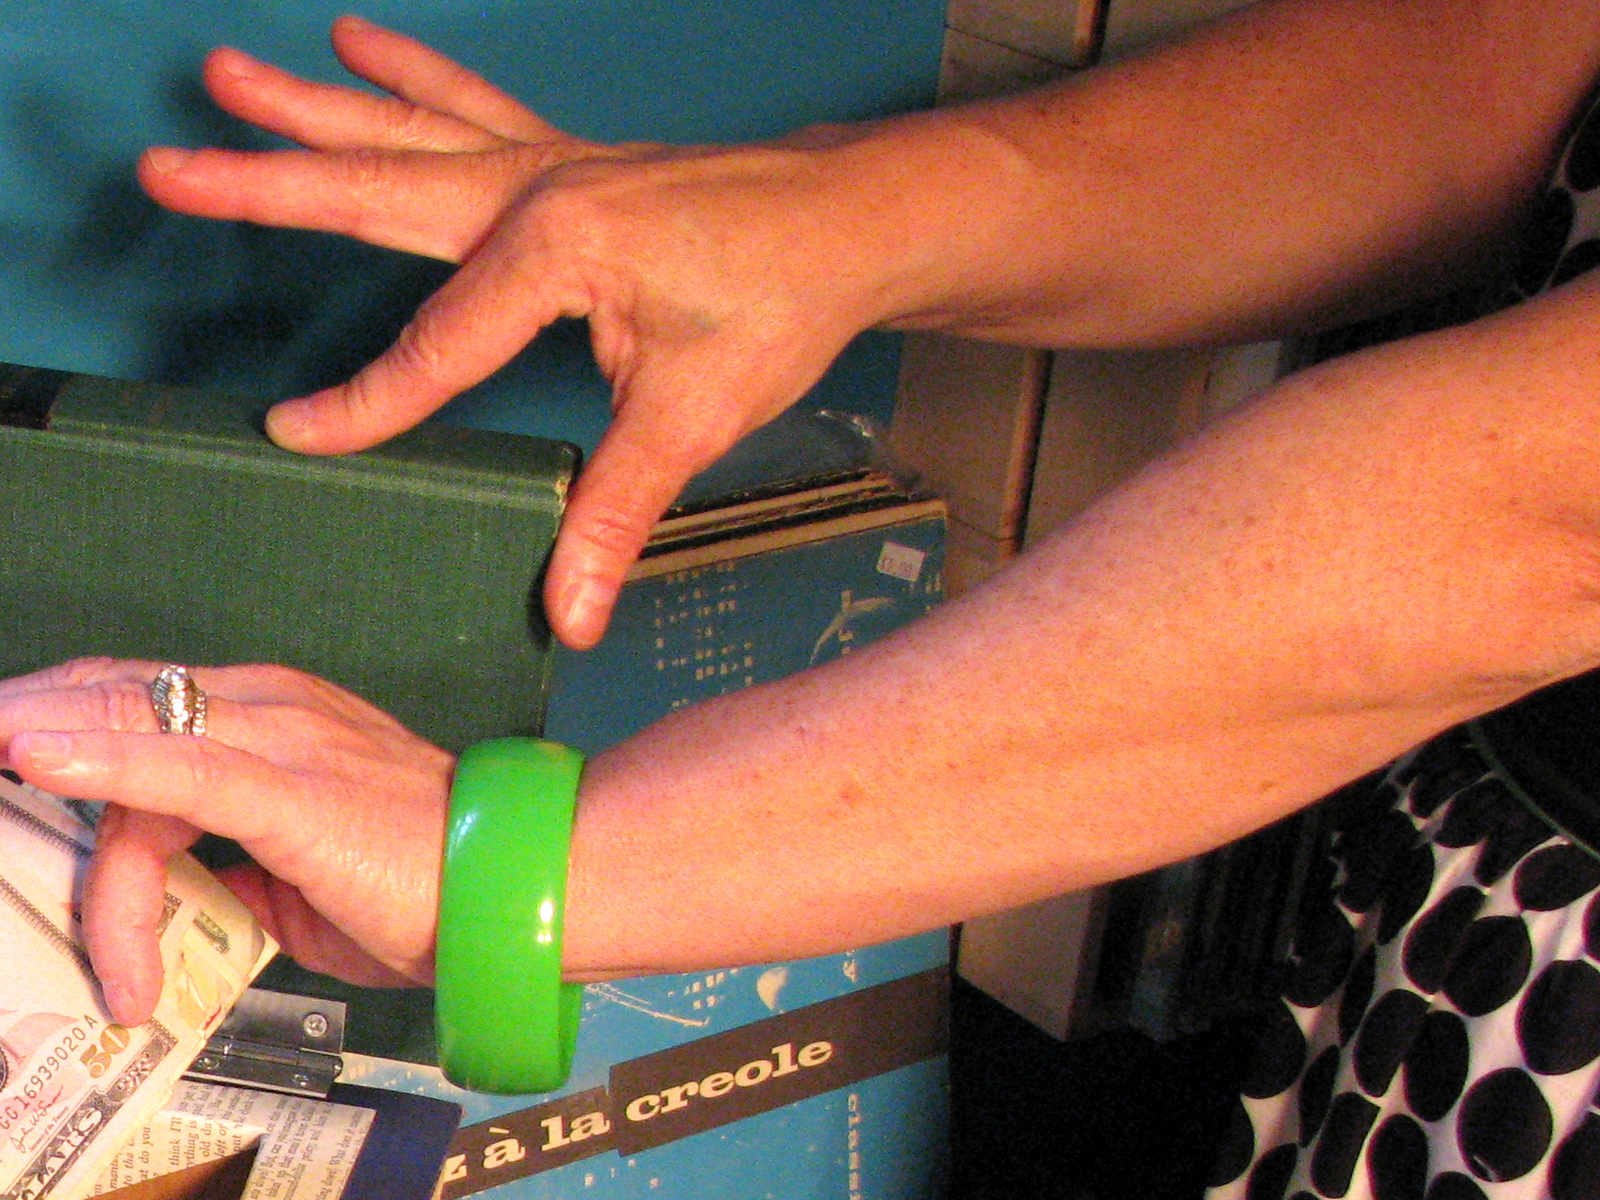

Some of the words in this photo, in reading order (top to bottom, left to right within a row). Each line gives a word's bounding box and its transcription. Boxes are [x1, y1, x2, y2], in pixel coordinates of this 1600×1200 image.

[79, 1023, 130, 1079] 50
[483, 1126, 526, 1171] à
[541, 1109, 611, 1153] la
[625, 1040, 834, 1123] creole
[186, 1119, 197, 1128] is
[165, 1137, 183, 1166] think
[197, 1140, 211, 1157] old
